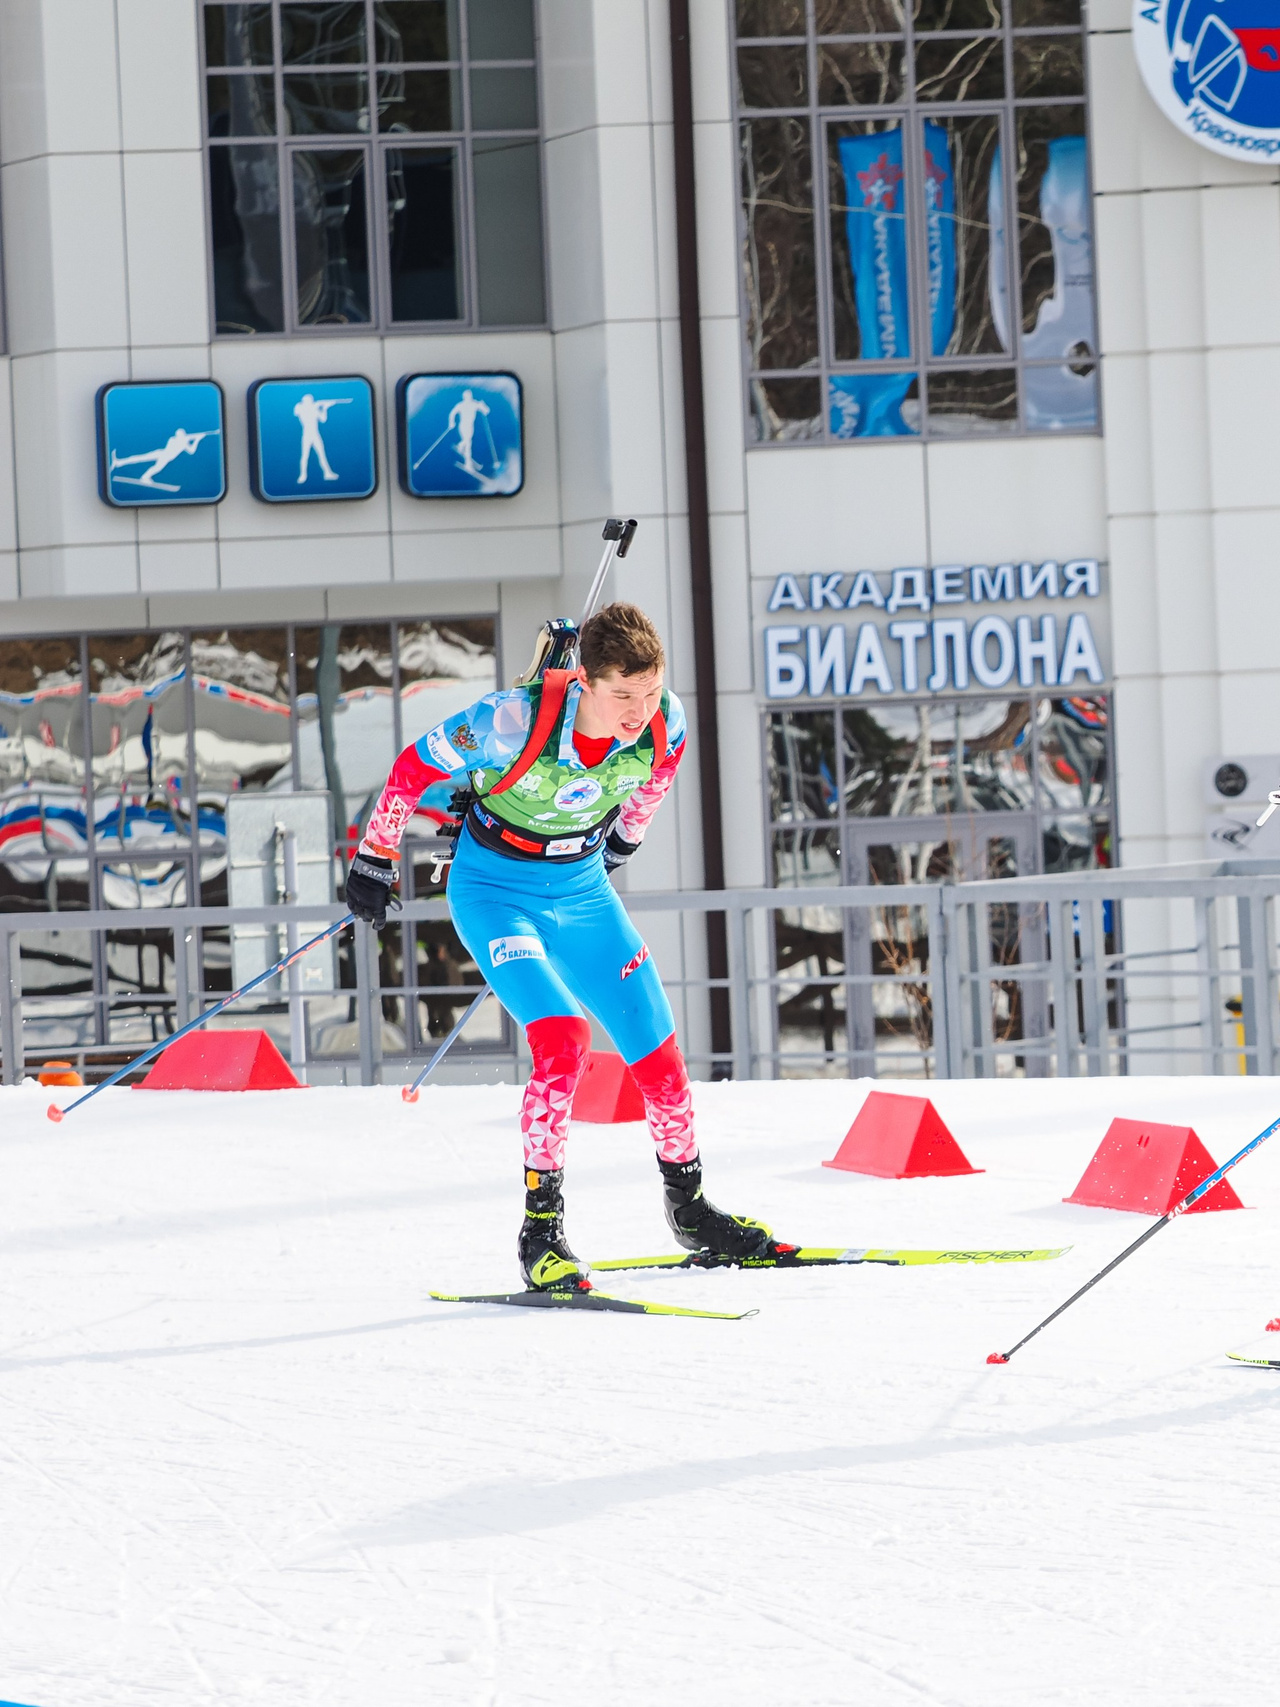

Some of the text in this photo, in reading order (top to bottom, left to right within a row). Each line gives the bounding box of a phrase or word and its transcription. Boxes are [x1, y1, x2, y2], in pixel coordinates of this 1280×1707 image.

[766, 558, 1100, 614] АКАДЕМИЯ
[763, 612, 1103, 698] БИАТЛОНА
[508, 948, 543, 959] GAZPROM
[937, 1250, 1034, 1260] FISCHER
[551, 1292, 573, 1301] FISCHER
